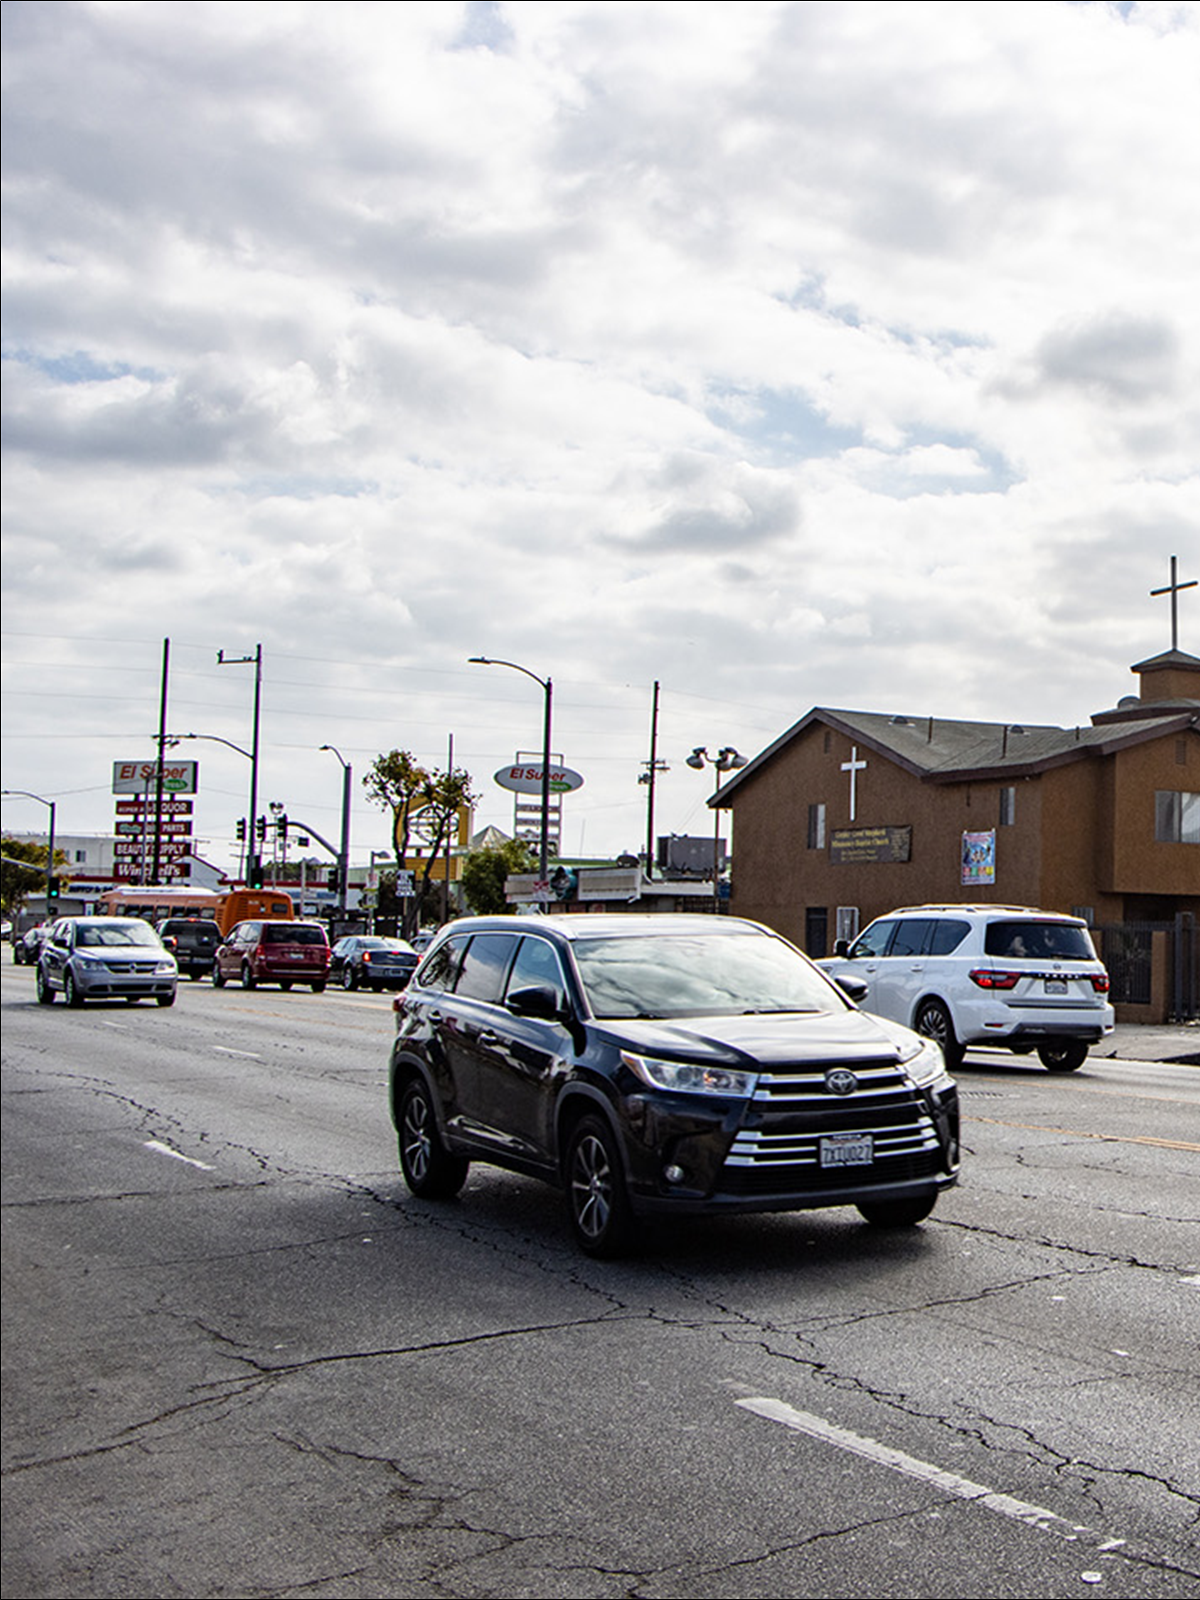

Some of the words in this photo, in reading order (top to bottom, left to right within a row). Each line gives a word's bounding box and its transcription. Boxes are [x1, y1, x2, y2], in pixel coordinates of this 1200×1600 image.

[120, 764, 137, 779] El
[140, 764, 188, 779] Sper
[510, 767, 524, 779] El
[525, 769, 566, 781] Suer
